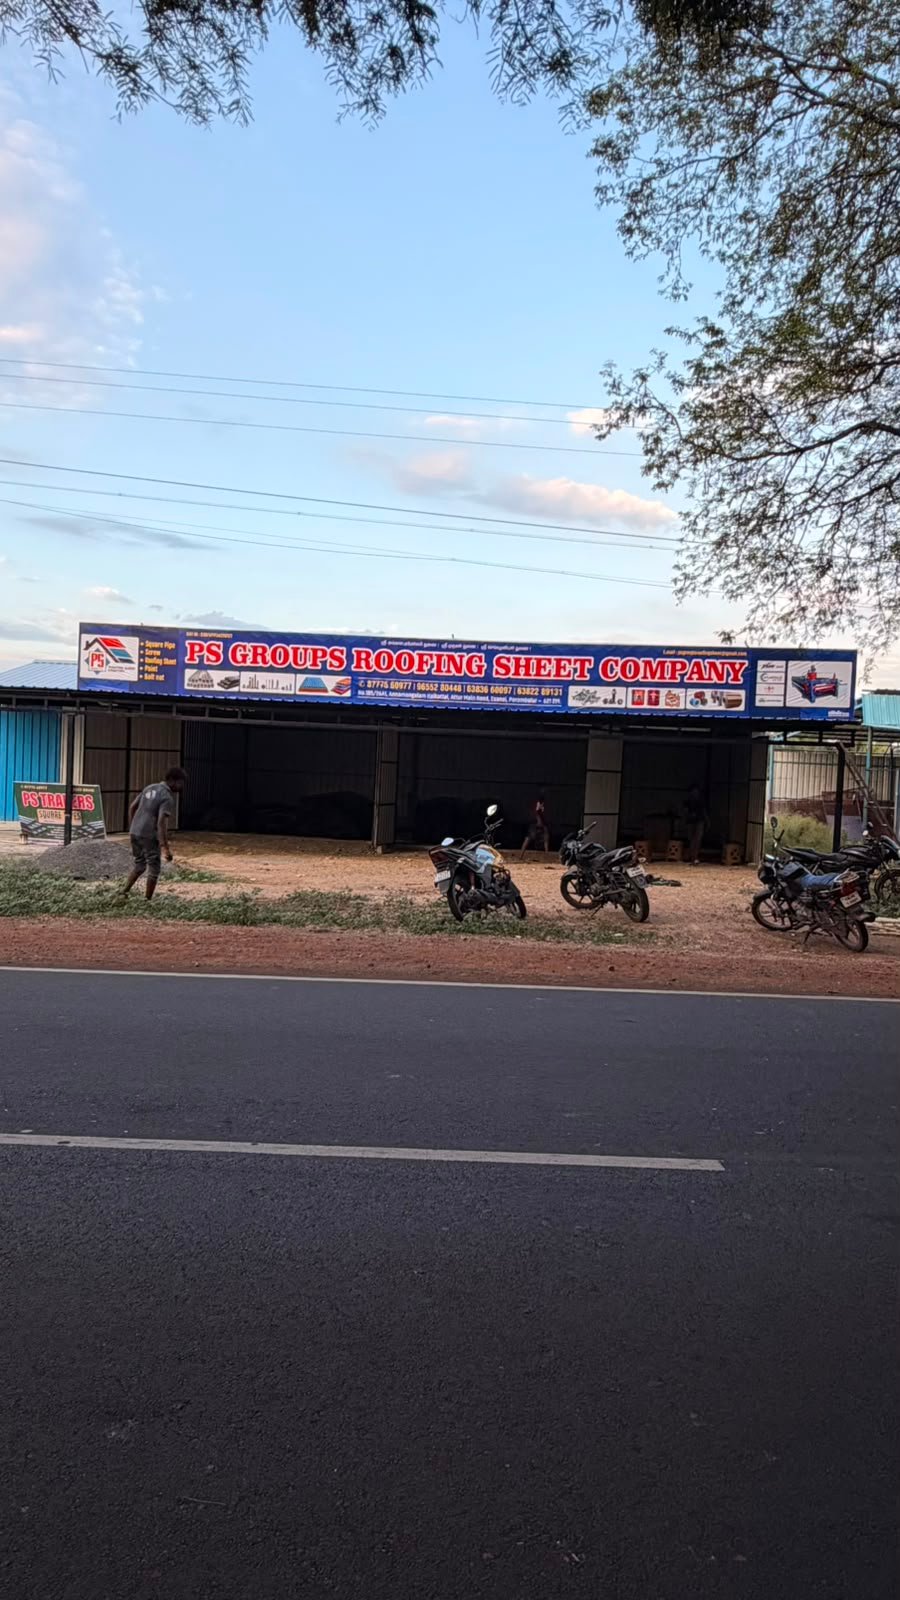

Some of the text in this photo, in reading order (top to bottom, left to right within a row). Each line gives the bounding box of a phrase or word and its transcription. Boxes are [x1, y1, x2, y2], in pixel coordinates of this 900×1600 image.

[145, 640, 176, 650] Square Pipe
[91, 653, 105, 668] PS
[145, 657, 163, 666] Roofing
[185, 640, 748, 684] PS GROUPS ROOFING SHEET COMPANY
[144, 665, 158, 673] Paint
[22, 791, 94, 811] PS TRAERS
